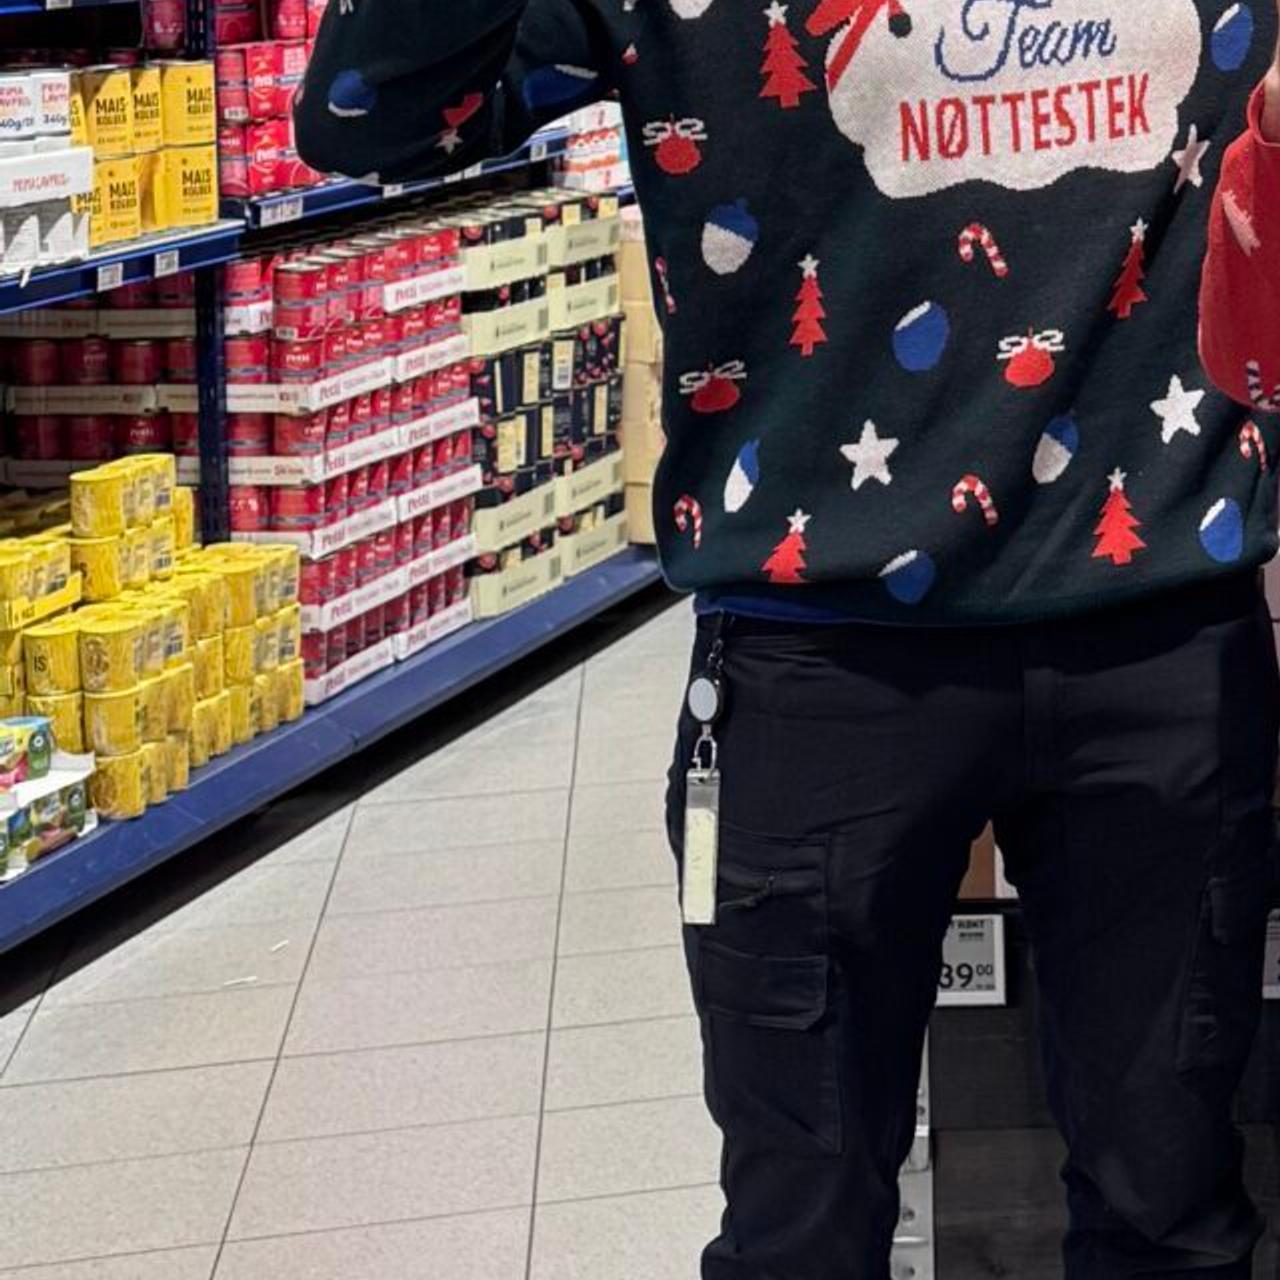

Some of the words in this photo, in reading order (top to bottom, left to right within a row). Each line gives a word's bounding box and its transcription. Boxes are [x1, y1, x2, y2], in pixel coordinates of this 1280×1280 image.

[95, 97, 126, 113] MAIS
[134, 92, 159, 109] MAIS
[900, 73, 1152, 162] NØTTESTEK
[182, 169, 211, 185] MAIS
[109, 181, 136, 199] MAIS
